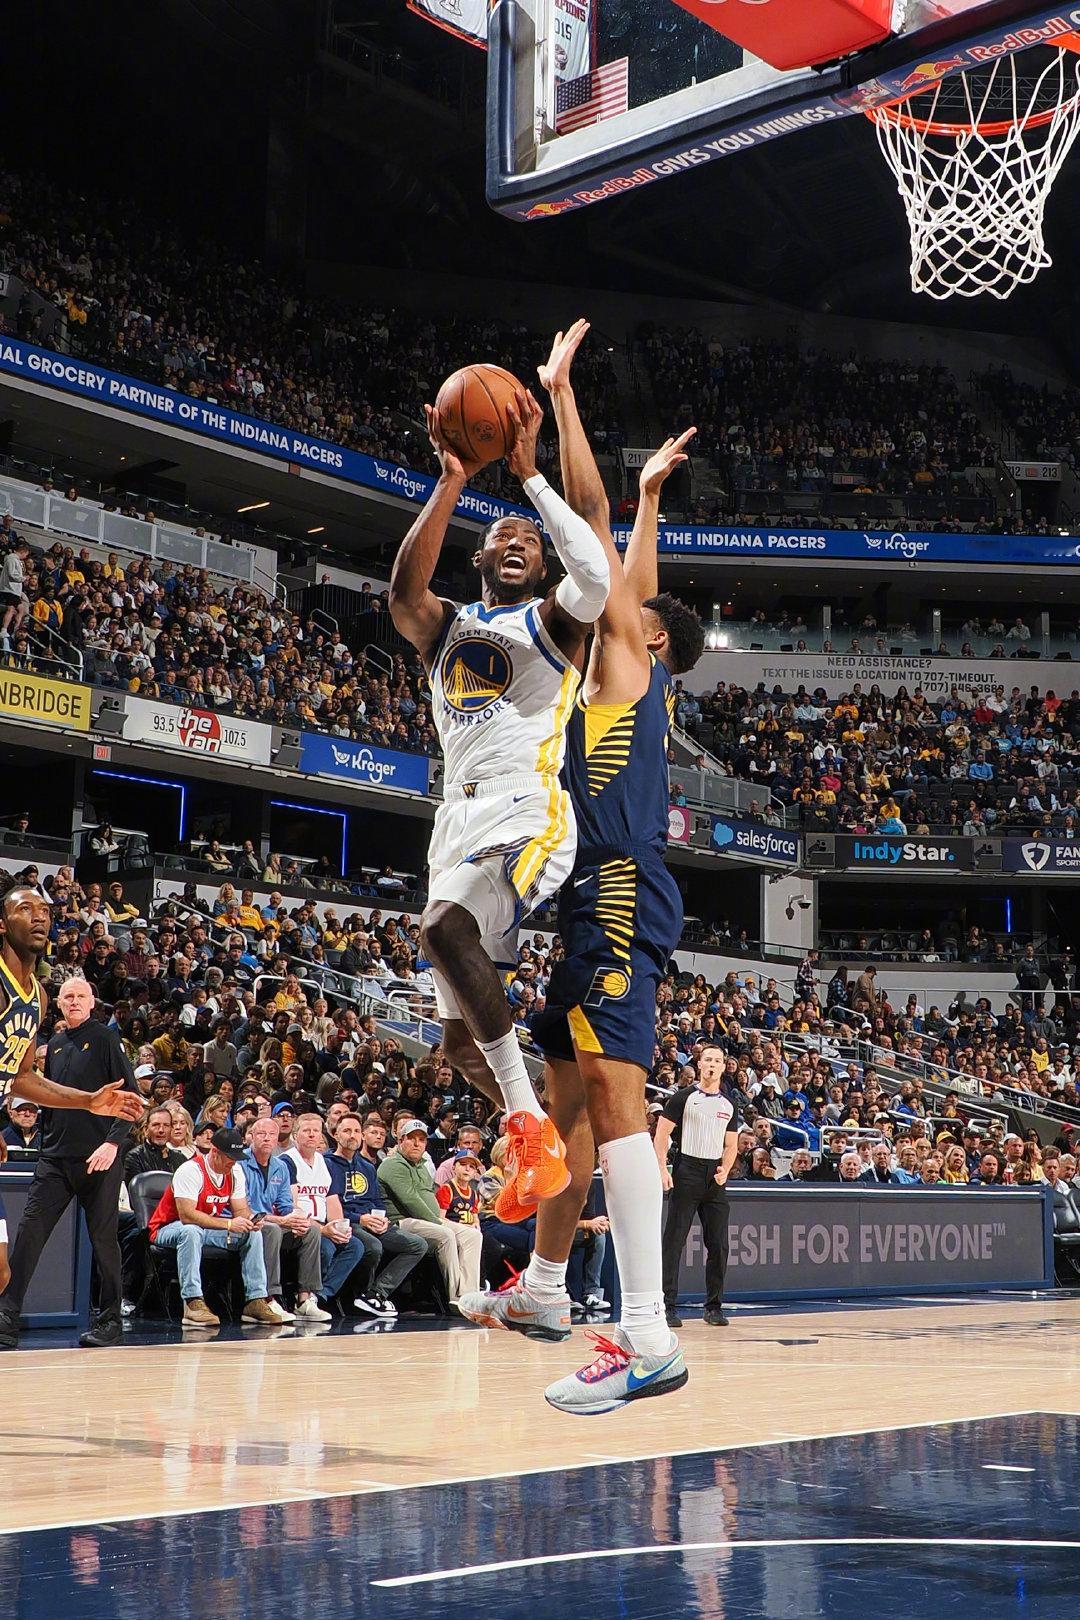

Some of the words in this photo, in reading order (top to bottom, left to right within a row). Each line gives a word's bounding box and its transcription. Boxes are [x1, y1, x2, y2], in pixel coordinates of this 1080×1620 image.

[652, 148, 711, 175] GIVES
[705, 132, 755, 153] YOU
[28, 354, 106, 391] GROCERY
[109, 380, 175, 414] PARTNER
[178, 403, 199, 421] OF
[201, 409, 227, 430] THE
[230, 419, 290, 451] INDIANA
[293, 439, 343, 468] PACERS
[390, 467, 427, 498] Kroger
[1042, 467, 1058, 478] 213
[664, 531, 692, 545] THE
[697, 532, 763, 548] INDIANA
[768, 535, 826, 549] PACERS
[885, 532, 929, 558] Kroger
[486, 630, 516, 652] STATE
[827, 656, 856, 667] NEED
[858, 657, 932, 669] ASSISTANCE?
[762, 668, 788, 678] TEXT
[790, 668, 810, 679] THE
[812, 669, 844, 679] ISSUE
[856, 670, 906, 680] LOCATION
[908, 671, 921, 681] TO
[924, 671, 997, 683] 707-TIMEOUT.
[177, 708, 213, 733] the
[443, 695, 512, 726] WARRIORS
[153, 714, 175, 733] 93.5
[184, 733, 222, 753] fan
[224, 729, 247, 748] 107.5
[352, 748, 396, 784] Kroger
[736, 829, 796, 855] salesforce
[854, 842, 955, 864] IndyStar.
[0, 1035, 32, 1074] 29
[686, 1224, 781, 1267] FESH
[792, 1223, 850, 1264] FOR
